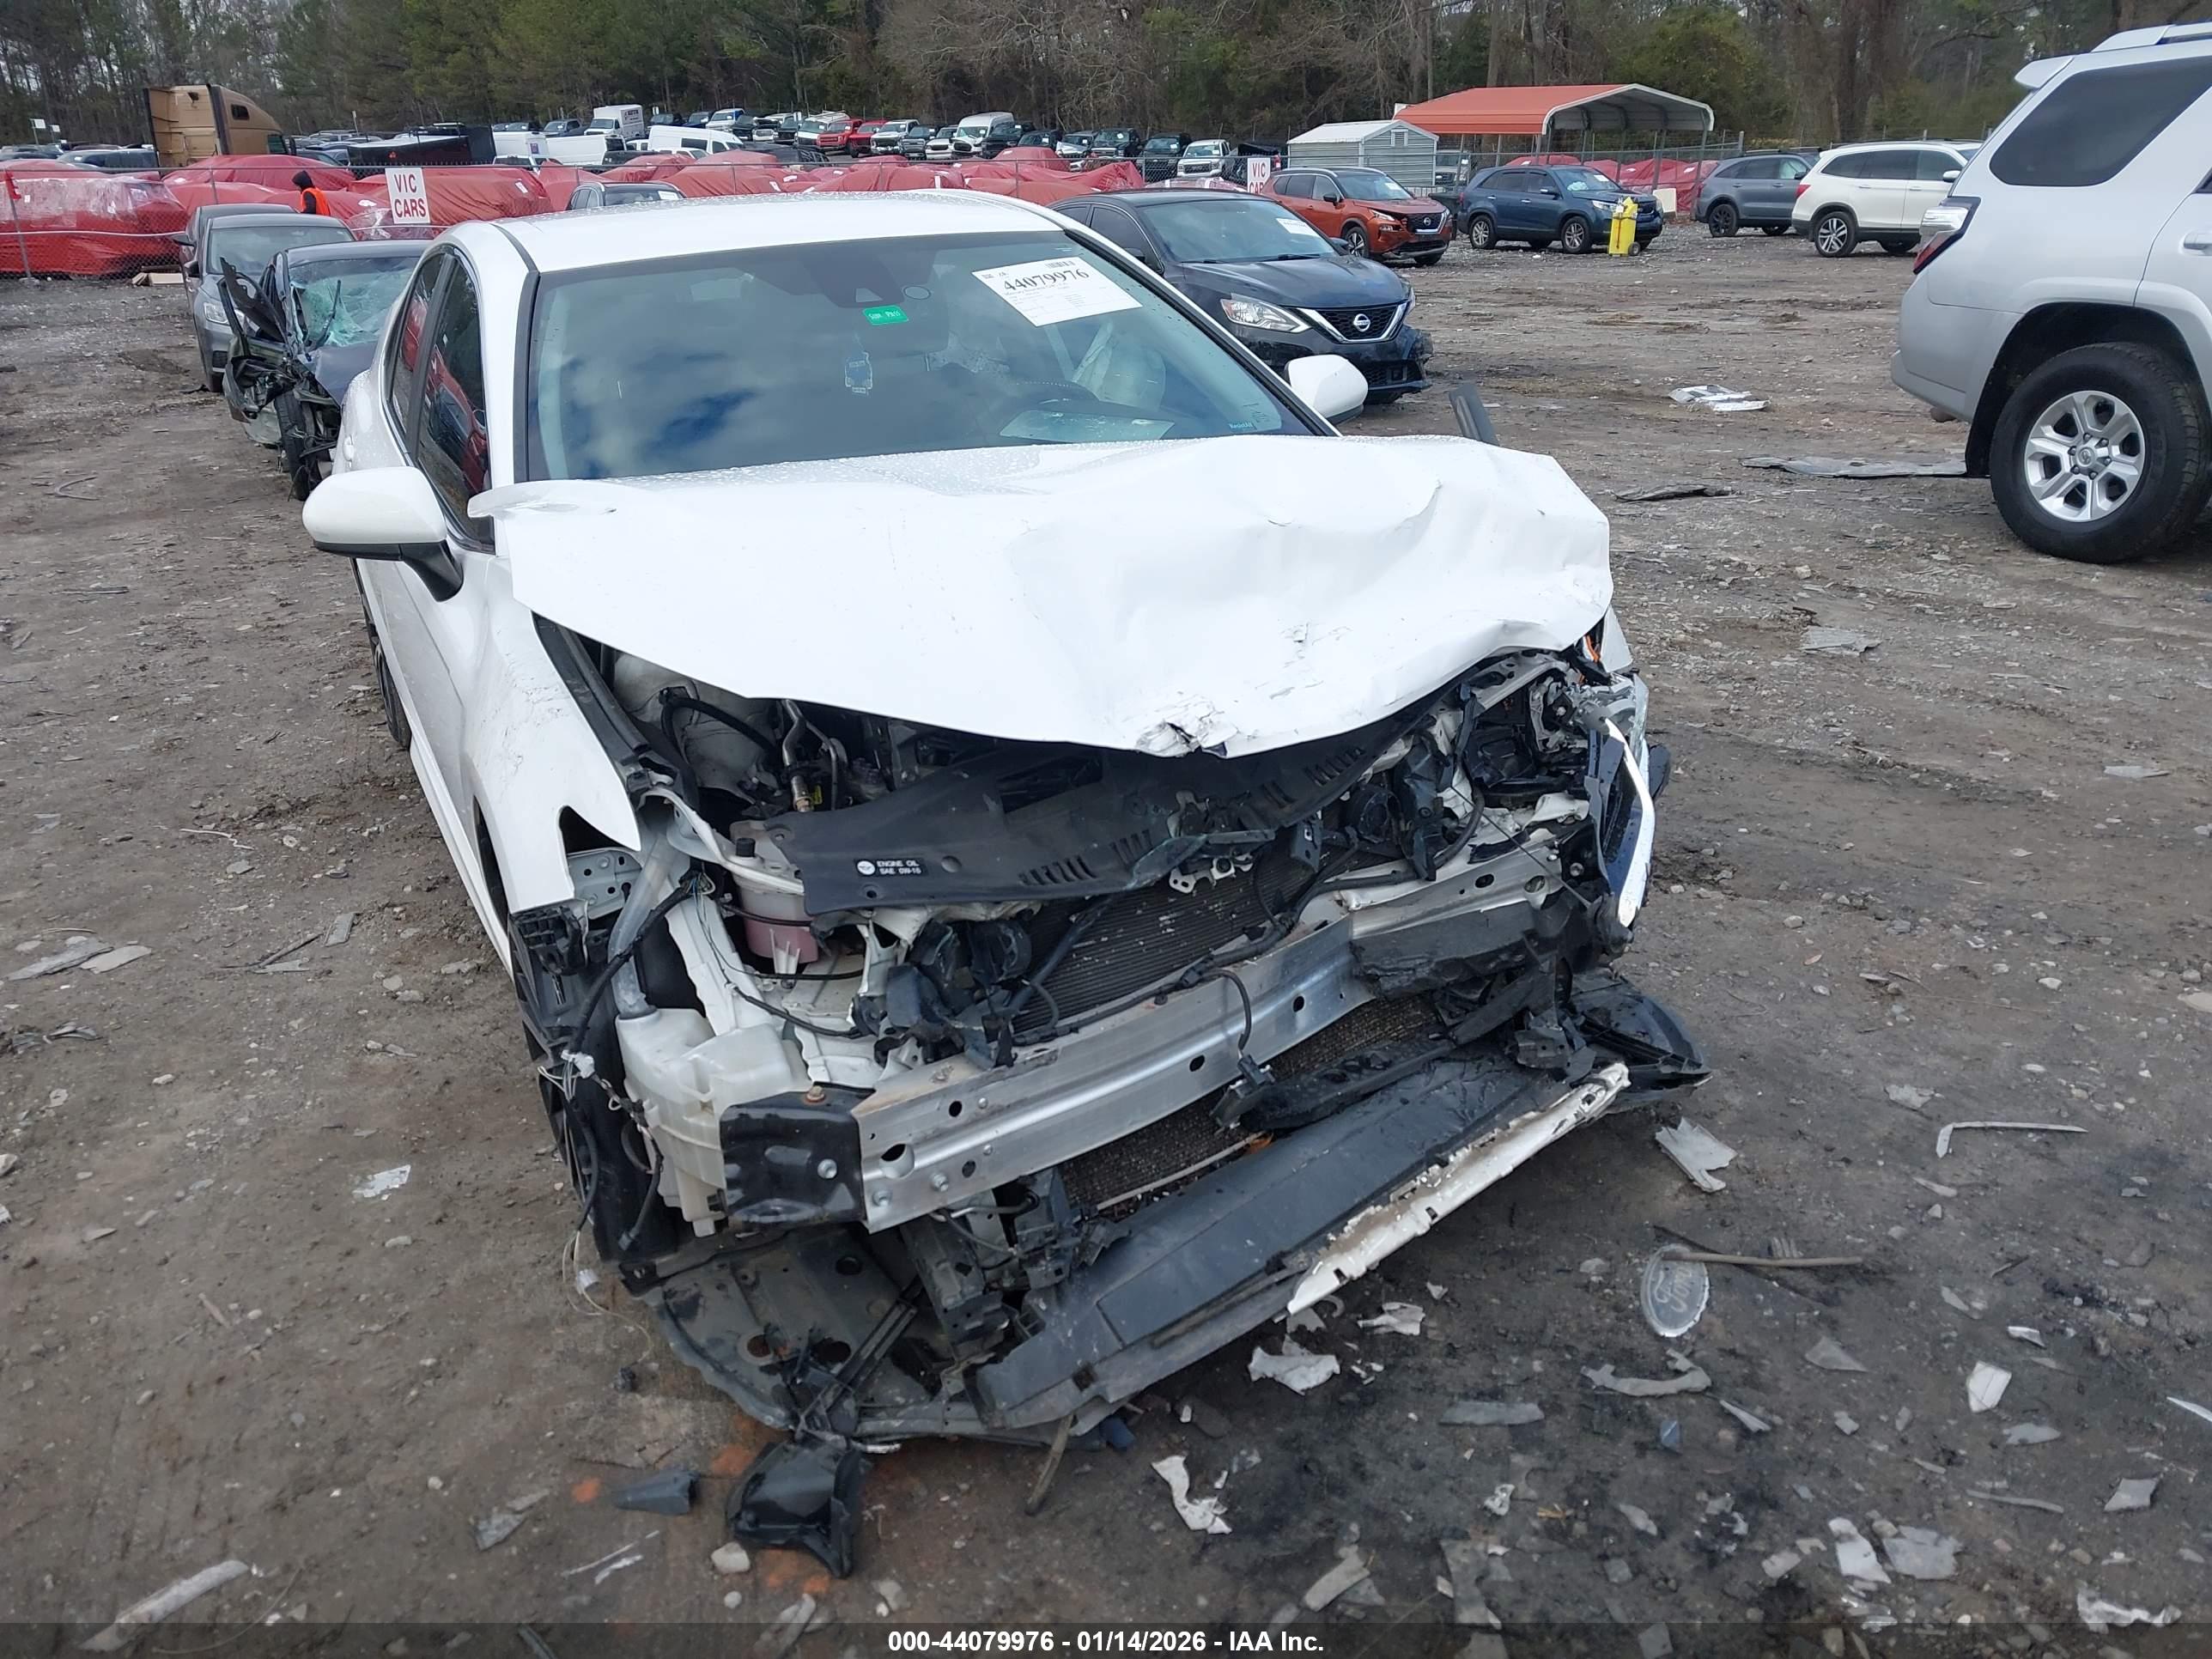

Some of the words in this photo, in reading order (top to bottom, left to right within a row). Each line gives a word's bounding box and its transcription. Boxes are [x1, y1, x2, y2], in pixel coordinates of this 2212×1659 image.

[1253, 163, 1266, 177] VIC
[394, 174, 416, 192] VIC
[1249, 182, 1264, 194] CAR
[395, 198, 426, 217] CARS
[1004, 268, 1090, 290] 44079976
